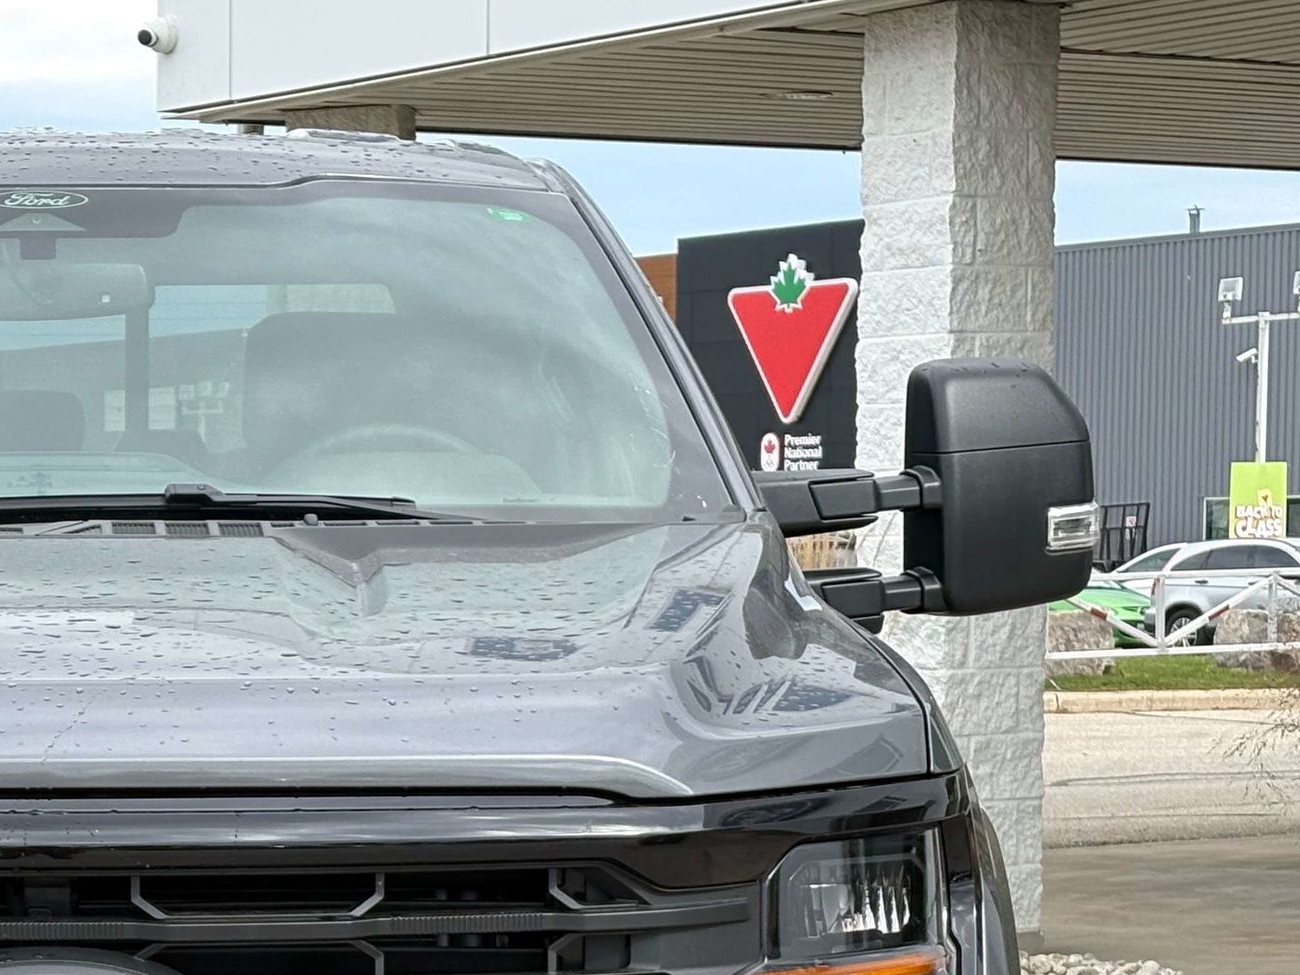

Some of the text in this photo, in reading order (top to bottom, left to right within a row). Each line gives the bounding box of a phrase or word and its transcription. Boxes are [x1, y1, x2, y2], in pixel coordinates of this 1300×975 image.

[4, 192, 71, 206] Ford
[784, 433, 821, 447] Premier
[784, 446, 823, 459] National
[784, 459, 819, 472] Partner
[1236, 504, 1283, 519] BACK TO
[1235, 519, 1283, 538] CLASS
